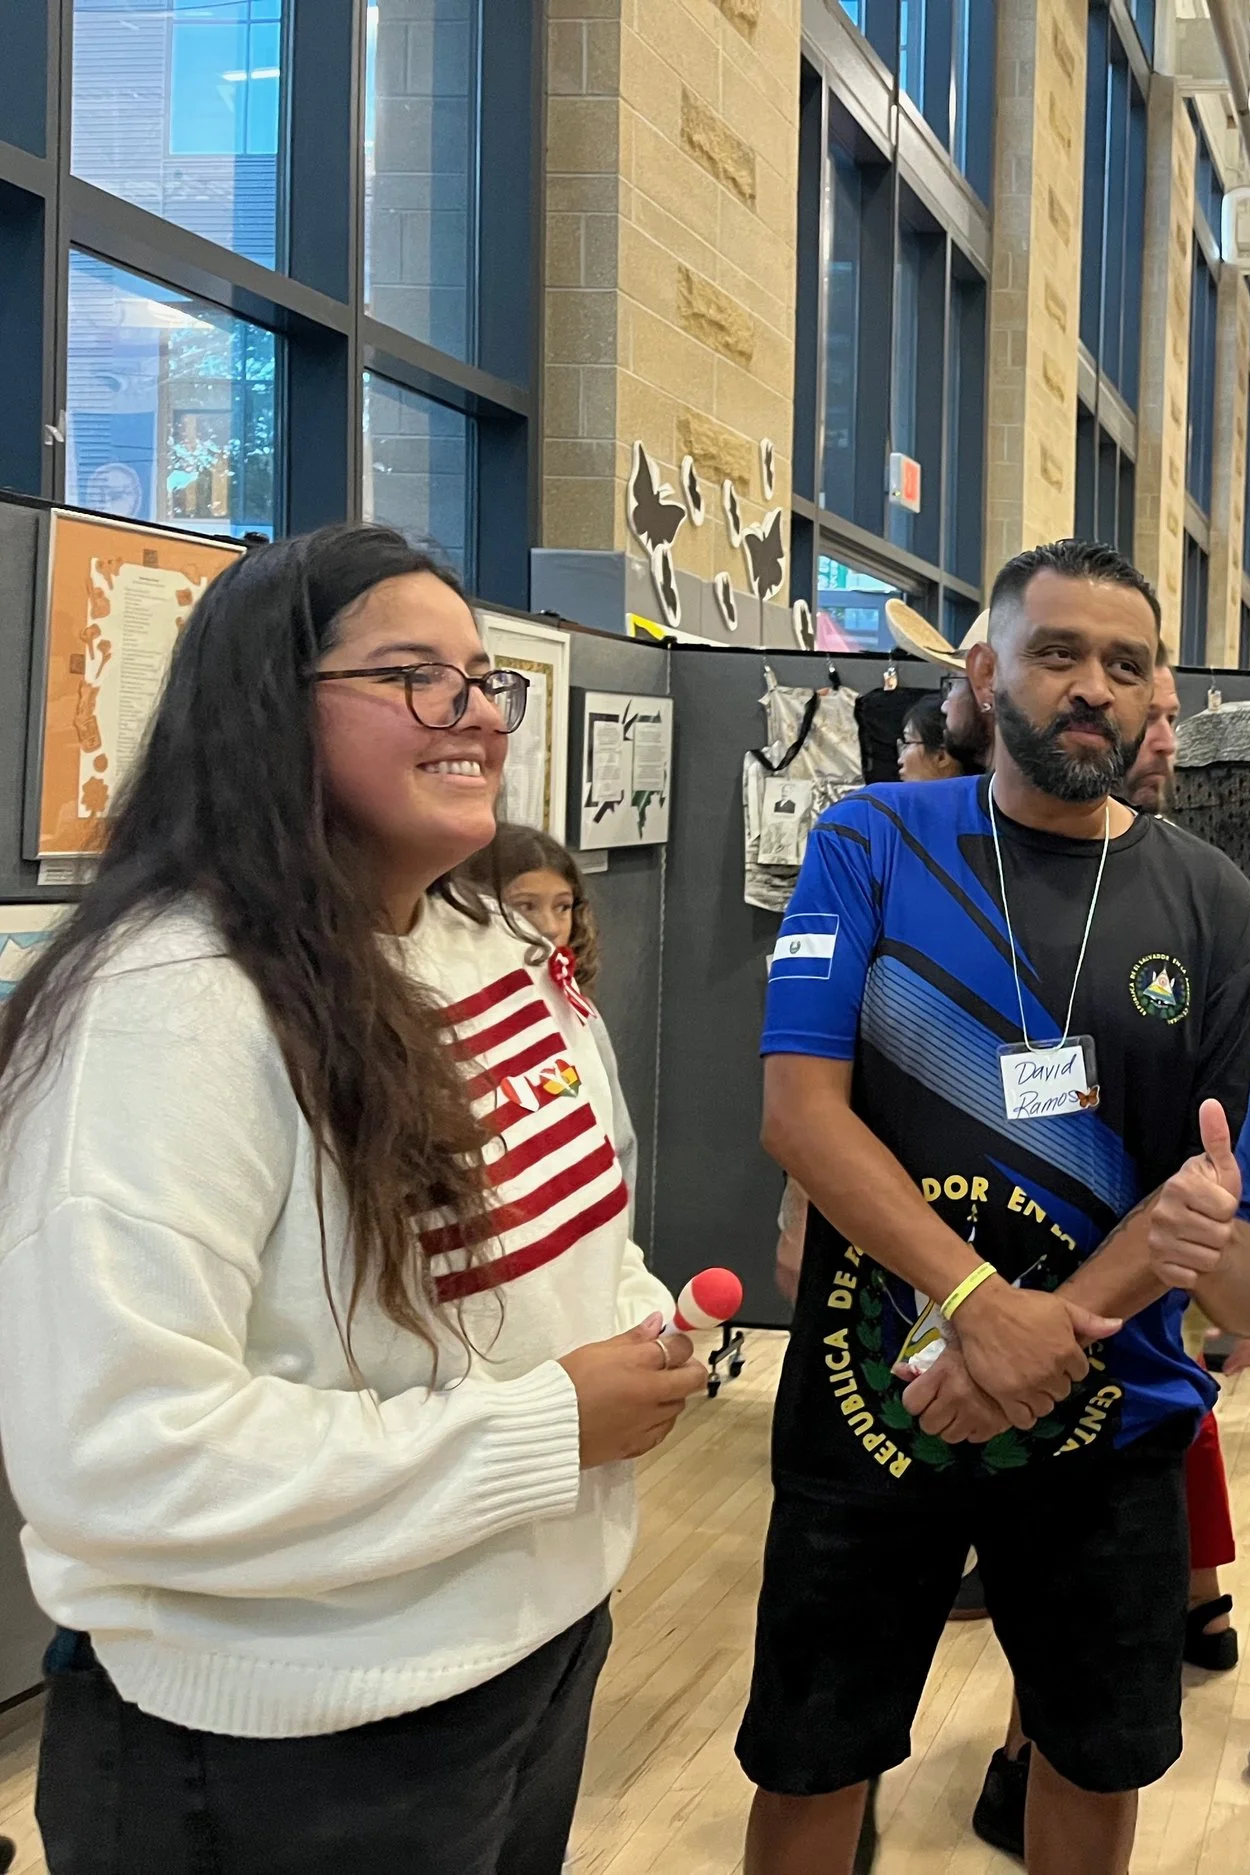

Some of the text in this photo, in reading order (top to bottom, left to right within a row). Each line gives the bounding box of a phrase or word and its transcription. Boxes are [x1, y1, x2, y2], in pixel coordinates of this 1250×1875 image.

[1014, 1053, 1077, 1085] David
[1013, 1090, 1079, 1119] Ramos
[1007, 1185, 1047, 1224] EN
[827, 1270, 857, 1310] DE
[823, 1328, 912, 1479] REPUBLICA
